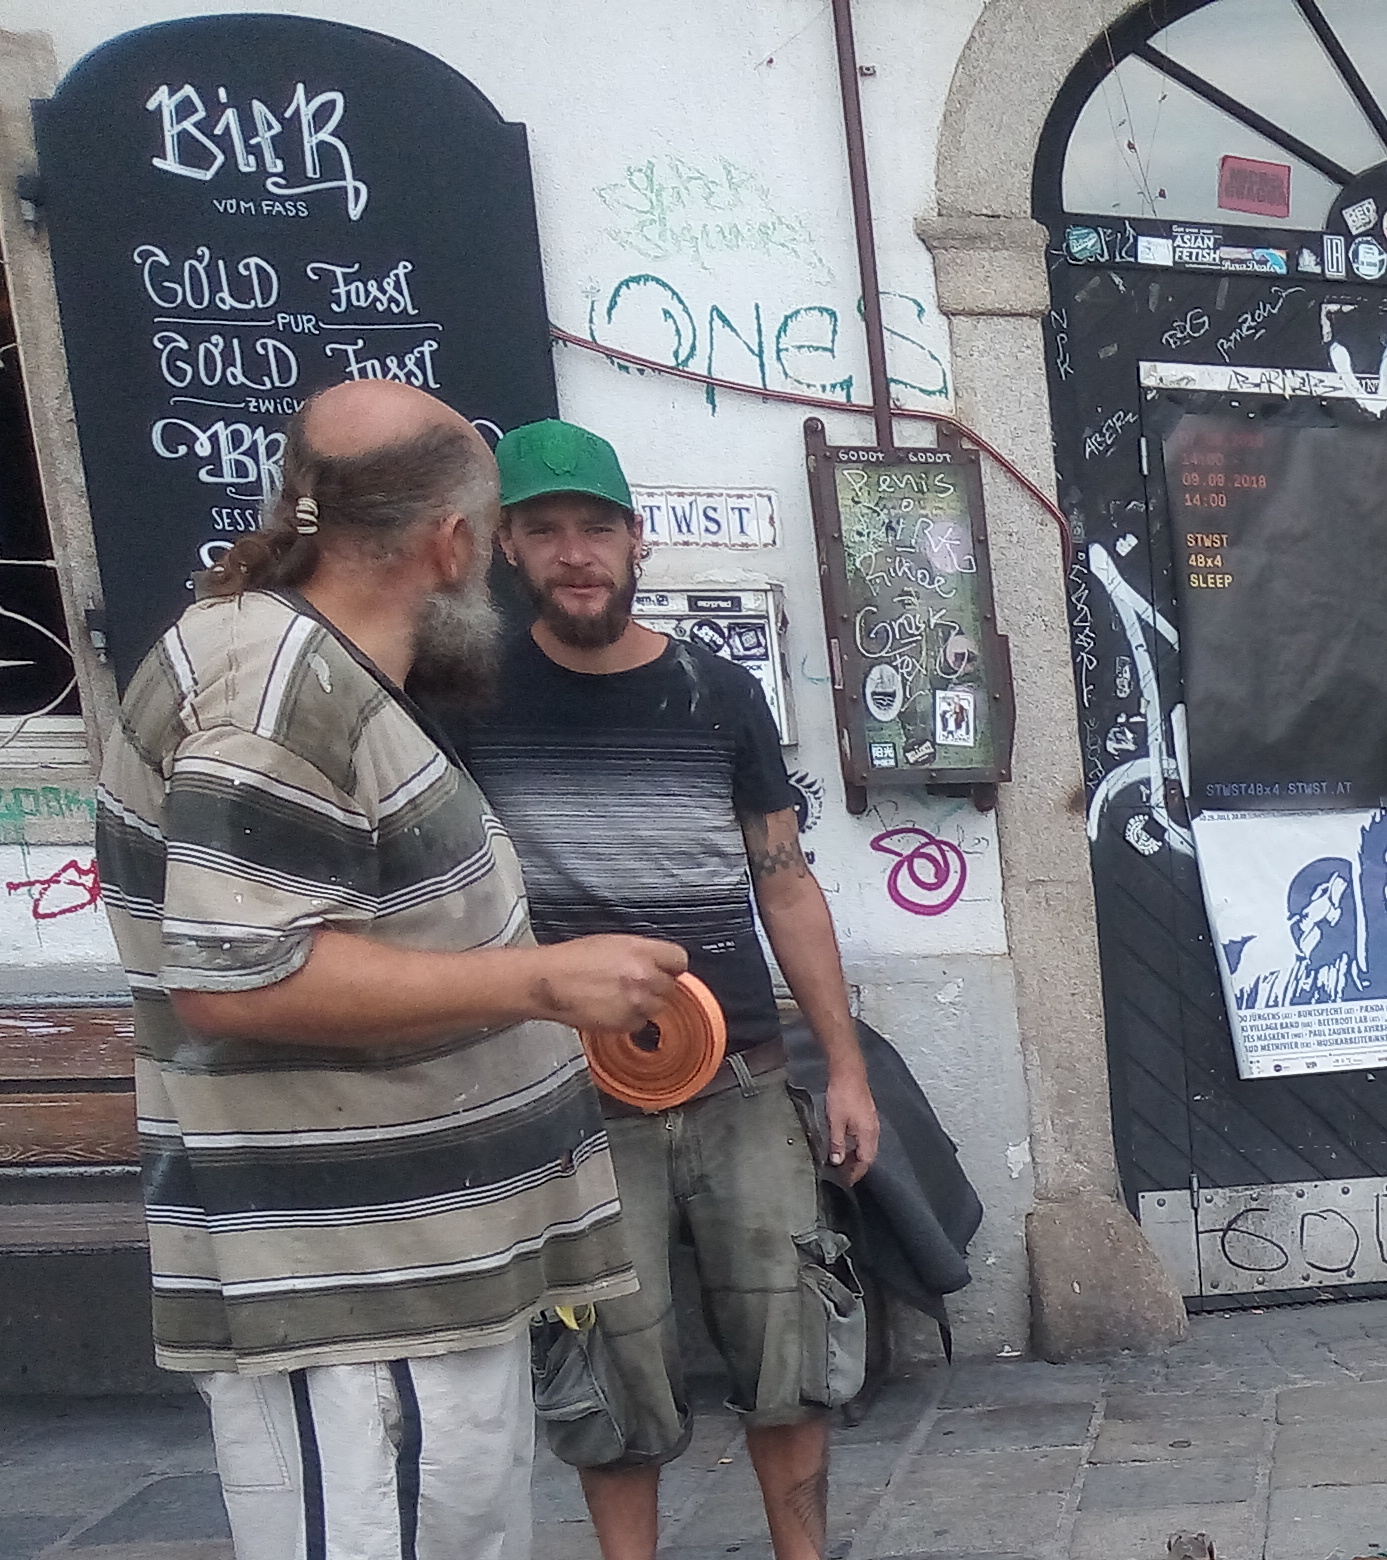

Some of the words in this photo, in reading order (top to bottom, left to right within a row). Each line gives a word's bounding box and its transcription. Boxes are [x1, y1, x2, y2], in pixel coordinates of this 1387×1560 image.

[212, 199, 256, 216] VOM
[261, 200, 309, 217] FASS
[1173, 235, 1214, 249] ASIAN
[1174, 247, 1220, 264] FETISH
[275, 312, 321, 334] PUR
[1184, 493, 1228, 508] 14:00
[1186, 533, 1230, 548] STWST
[1188, 553, 1225, 568] 48x4
[1188, 573, 1234, 588] SLEEP
